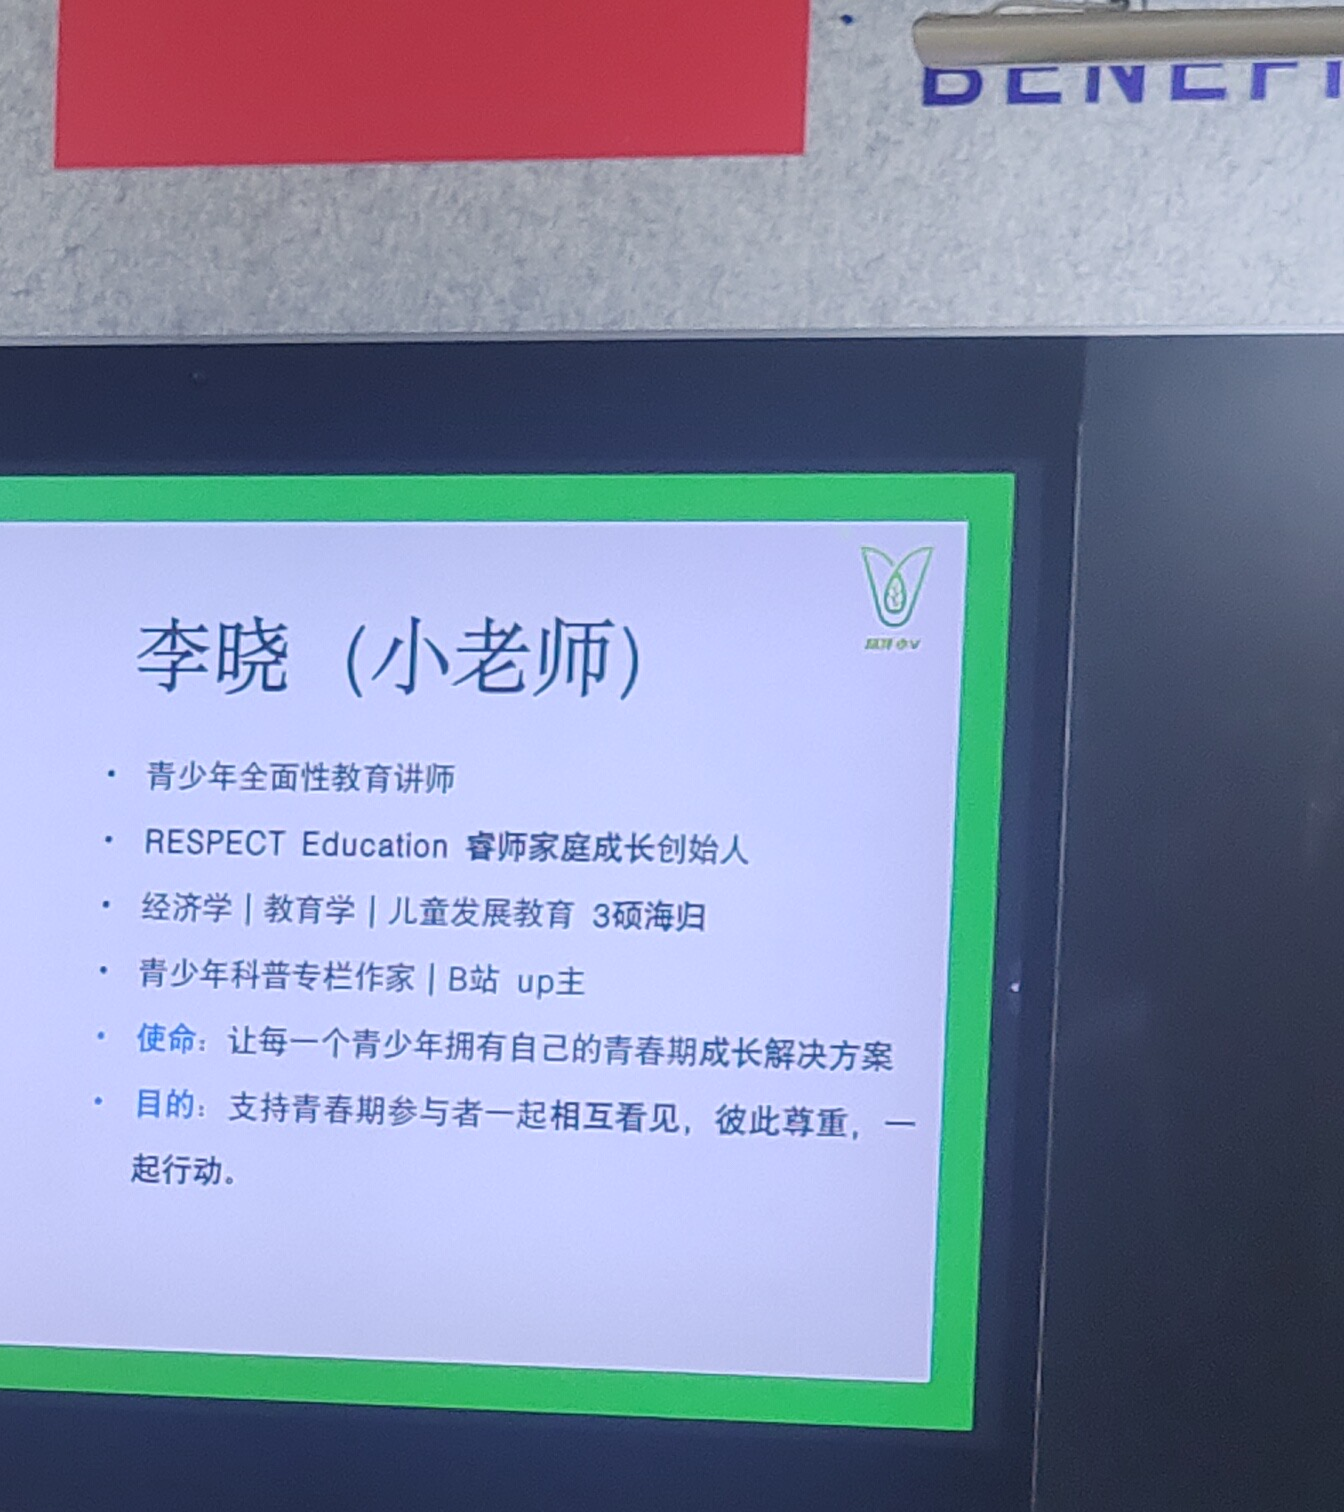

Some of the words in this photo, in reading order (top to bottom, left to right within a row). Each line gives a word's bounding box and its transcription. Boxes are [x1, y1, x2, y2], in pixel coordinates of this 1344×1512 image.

[137, 615, 640, 699] 李晓（小老师）
[147, 760, 455, 794] 青少年全面性教育讲师
[145, 828, 286, 856] RESPECT
[302, 831, 448, 859] Education
[466, 830, 749, 865] 睿师家庭成长创始人
[592, 900, 705, 932] 3硕海归
[518, 966, 585, 1000] up主
[130, 1152, 235, 1186] 起行动。
